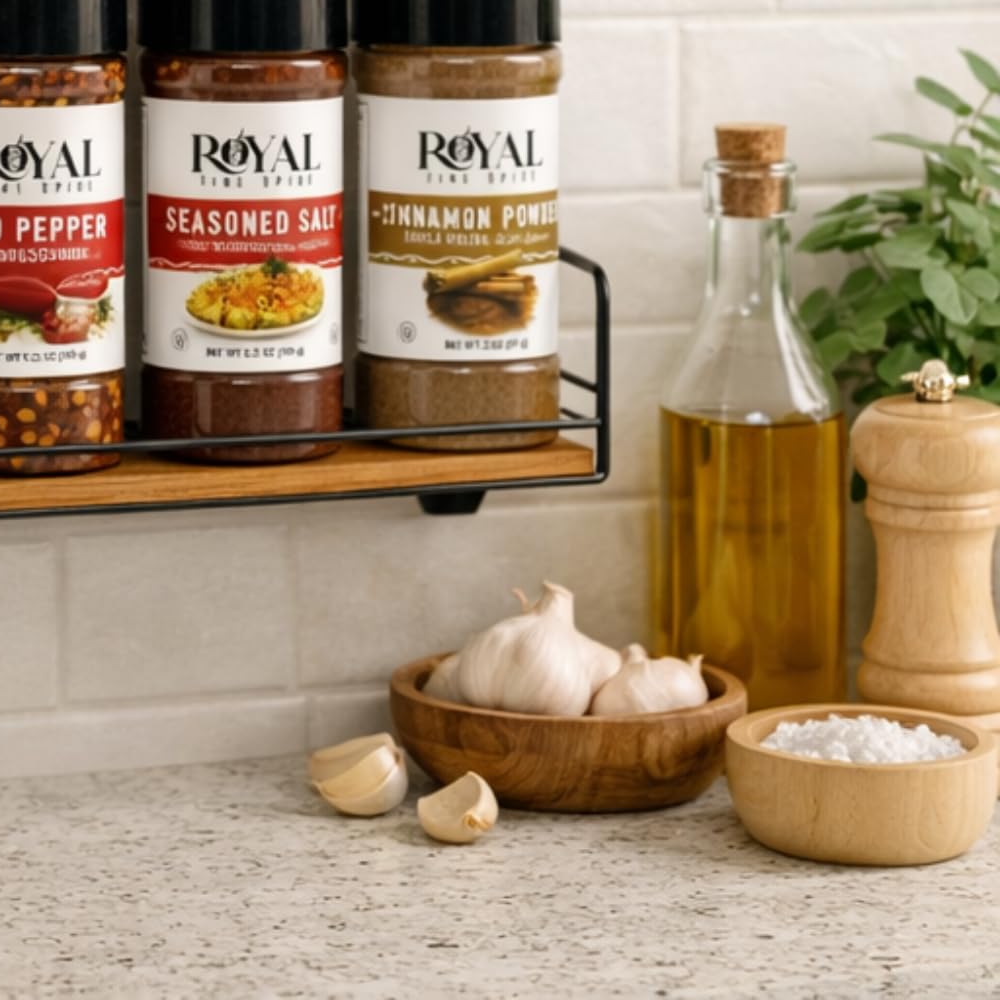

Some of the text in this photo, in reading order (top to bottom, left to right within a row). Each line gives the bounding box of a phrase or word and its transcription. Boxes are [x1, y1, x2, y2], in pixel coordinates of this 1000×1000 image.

[190, 128, 321, 174] ROYAL
[418, 126, 543, 171] ROYAL
[16, 213, 106, 242] PEPPER
[166, 204, 336, 236] SEASONED SALT
